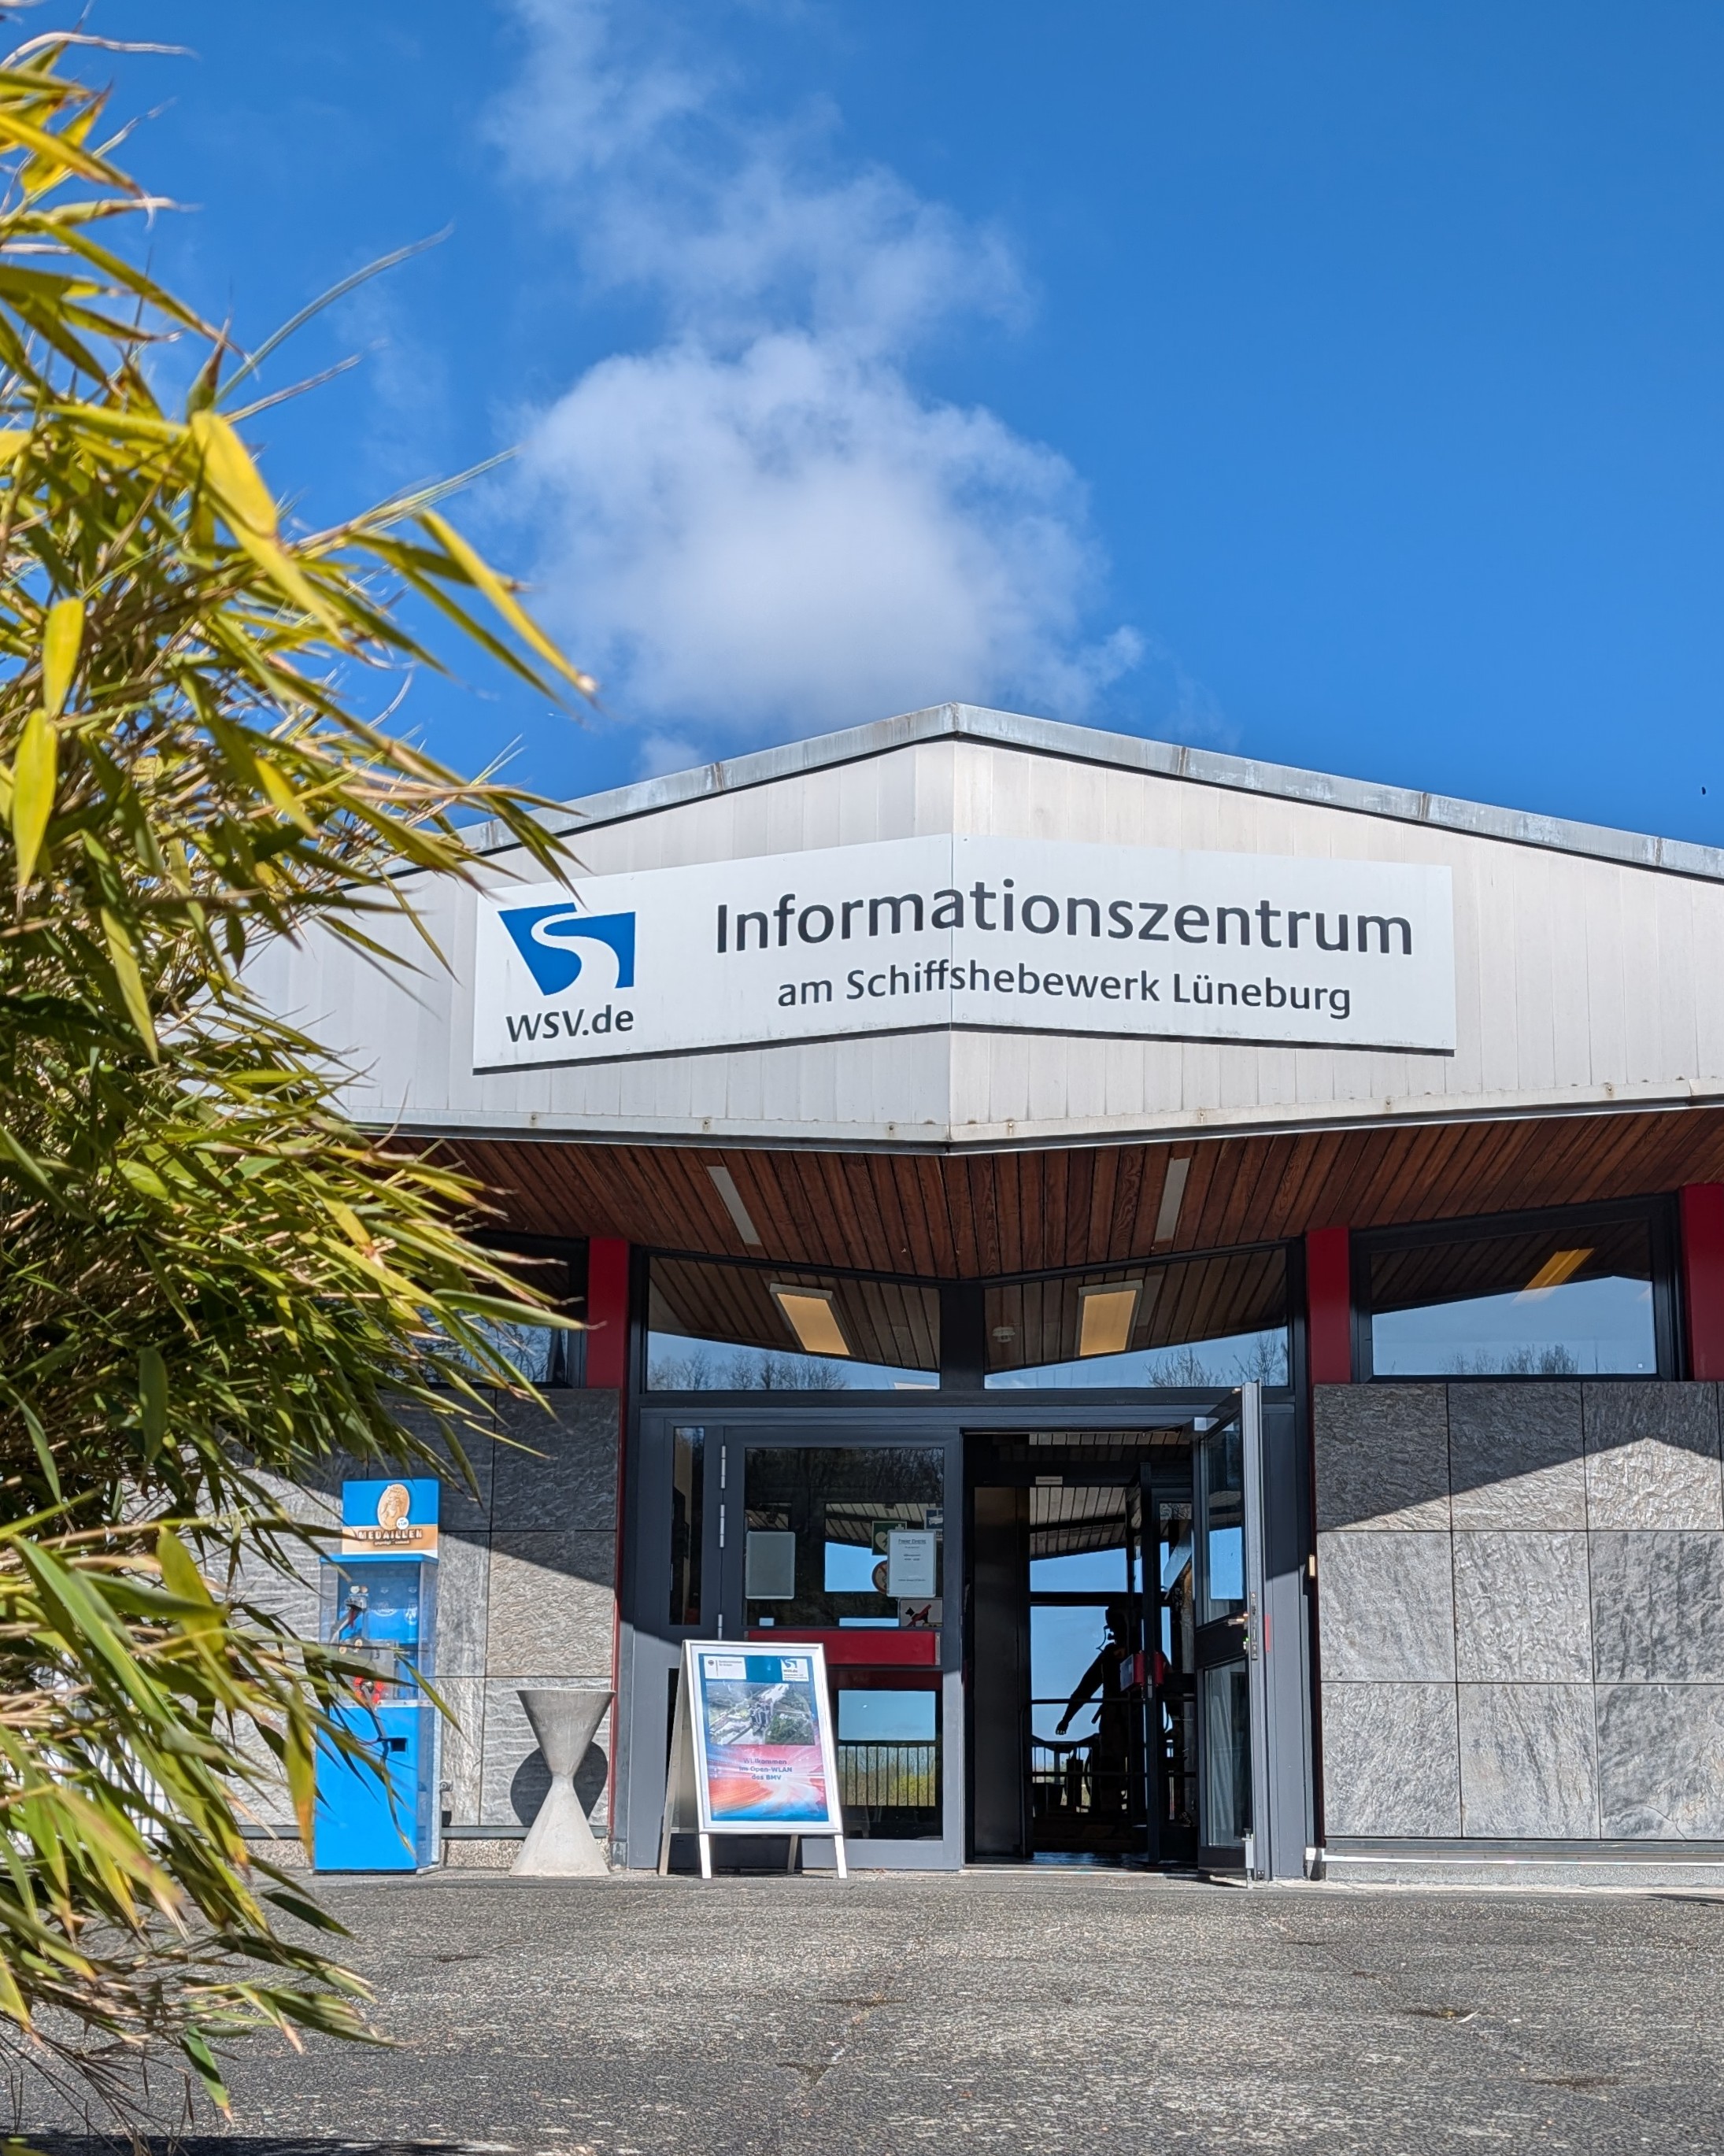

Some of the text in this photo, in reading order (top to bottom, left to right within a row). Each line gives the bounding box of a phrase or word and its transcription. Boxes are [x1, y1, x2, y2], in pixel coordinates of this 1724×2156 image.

[717, 878, 1412, 956] Informationszentrum
[778, 959, 1350, 1020] am Schiffshebewerk Lüneburg
[505, 1004, 634, 1043] WSV.de
[358, 1529, 423, 1540] MEDAILLEN
